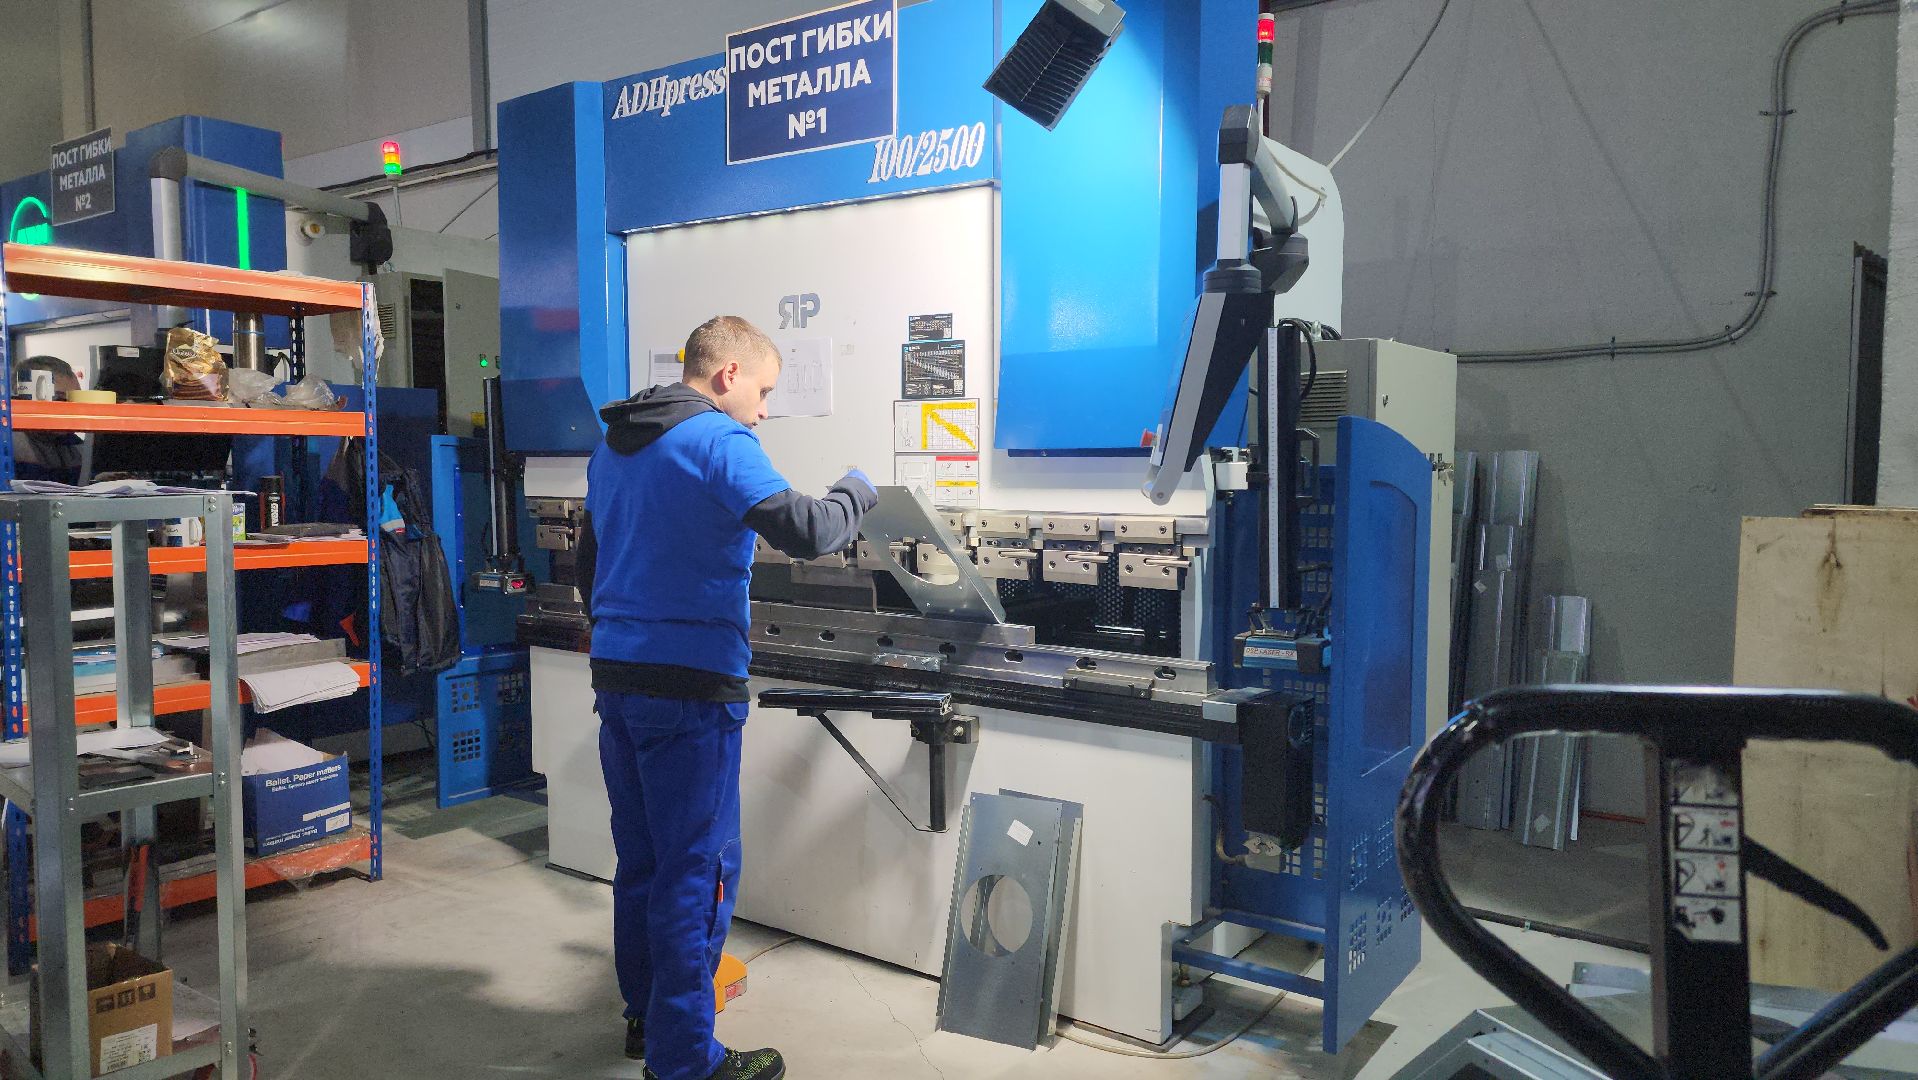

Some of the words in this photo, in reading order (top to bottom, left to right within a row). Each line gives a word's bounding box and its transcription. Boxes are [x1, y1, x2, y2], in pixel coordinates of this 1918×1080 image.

[730, 34, 797, 74] ПОСТ
[802, 11, 893, 60] ГИБКИ
[611, 65, 728, 118] ADHpress
[748, 59, 871, 108] МЕТАЛЛА
[788, 107, 828, 140] №1
[52, 147, 79, 169] ПОСТ
[80, 136, 112, 162] ГИБКИ
[867, 121, 986, 184] 100/2500
[60, 164, 106, 191] МЕТАЛЛА
[75, 193, 92, 212] №2
[293, 771, 316, 782] Paper
